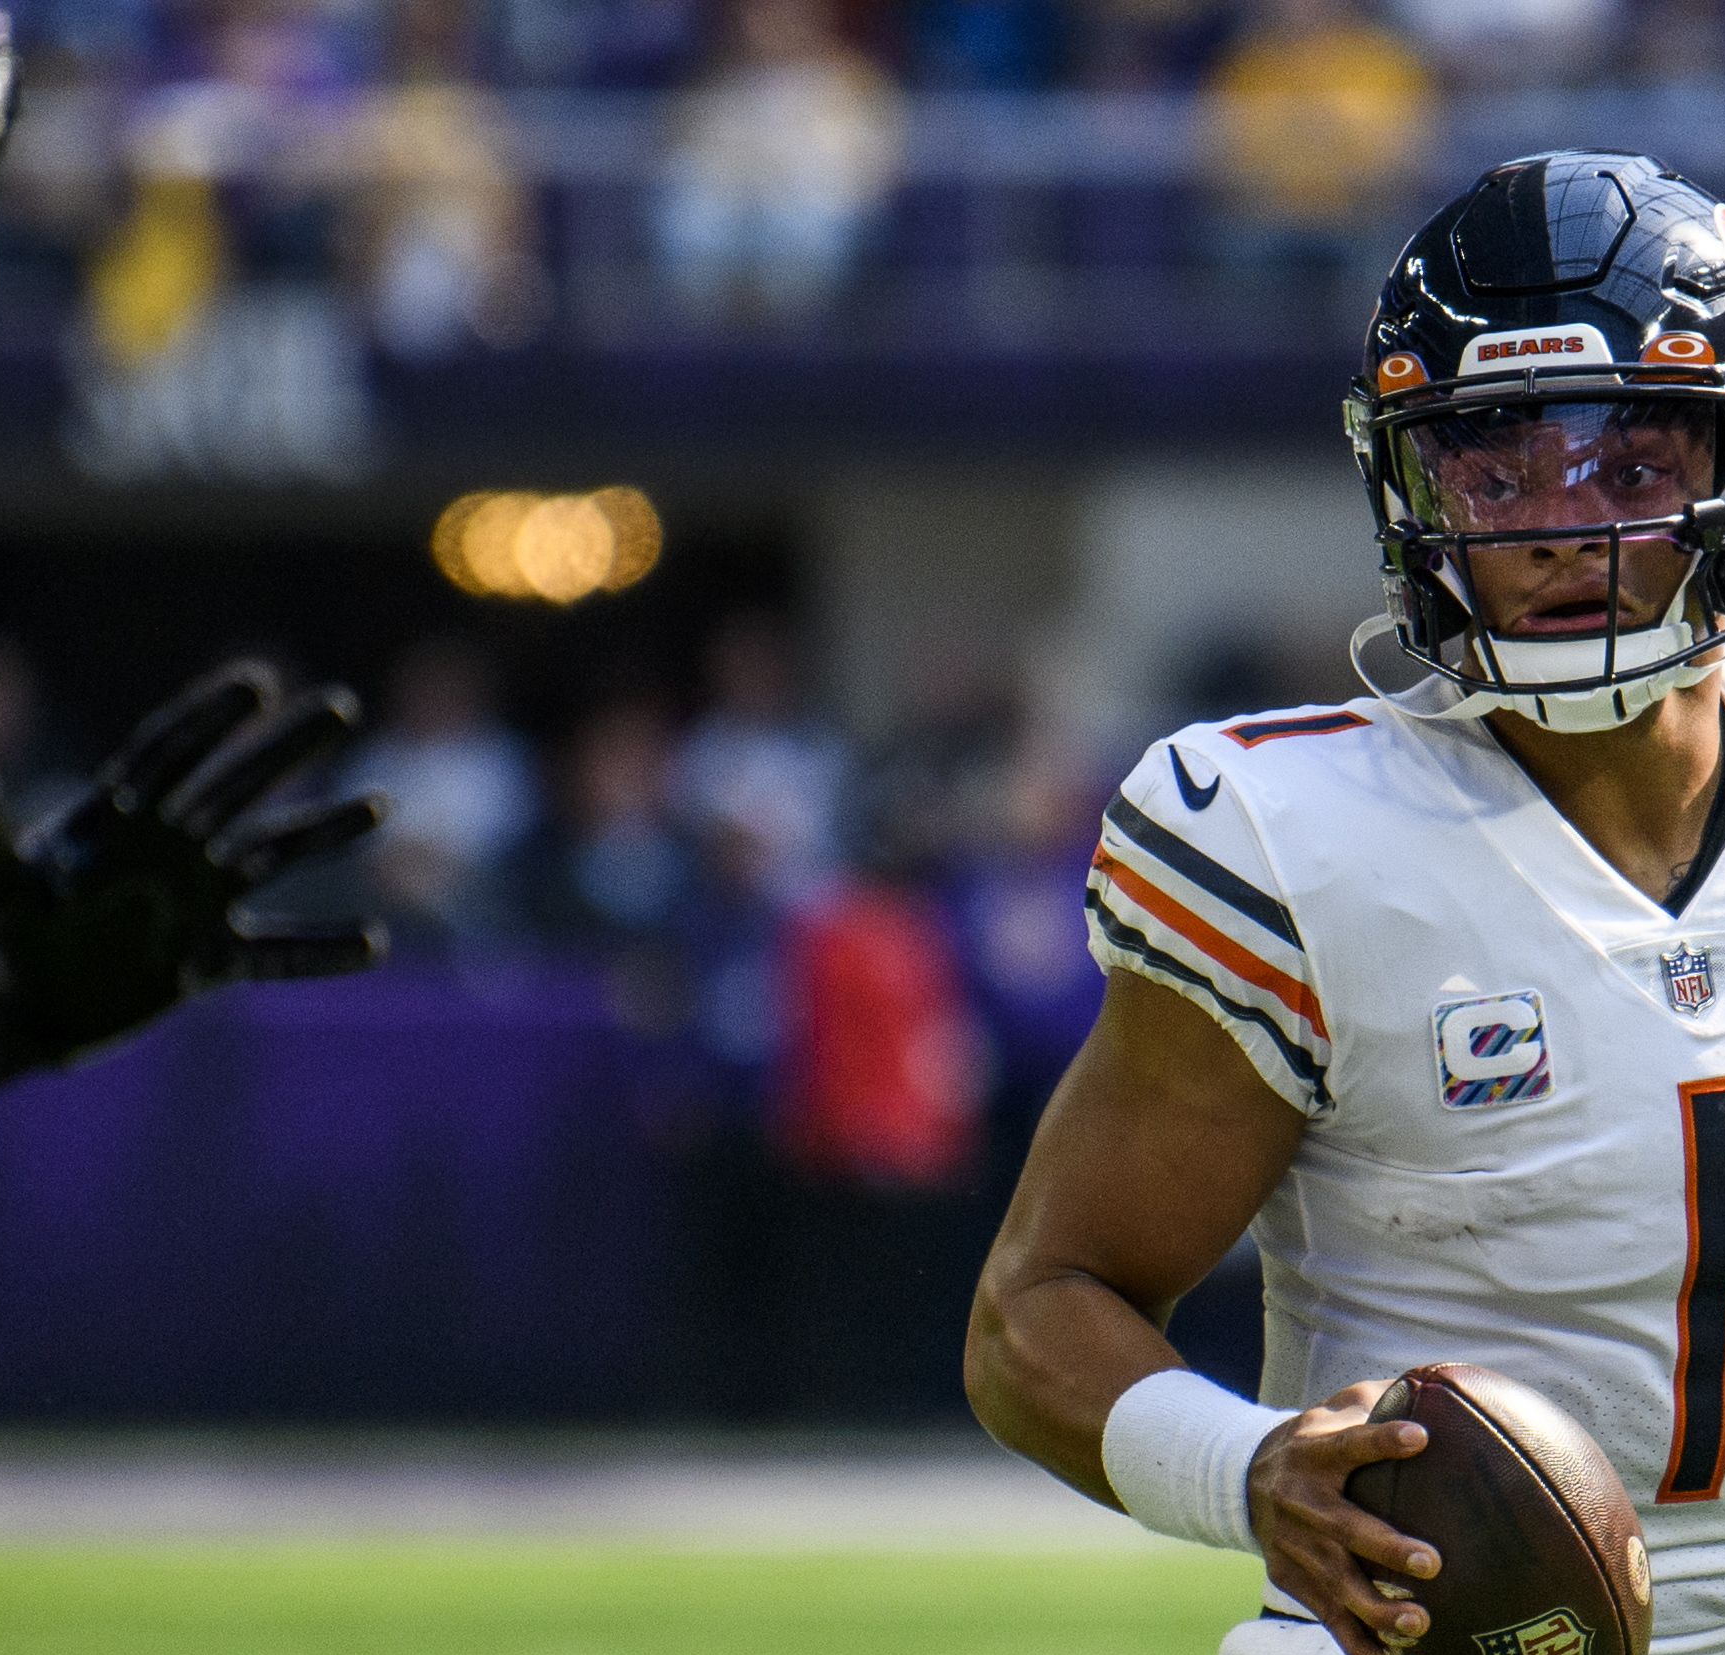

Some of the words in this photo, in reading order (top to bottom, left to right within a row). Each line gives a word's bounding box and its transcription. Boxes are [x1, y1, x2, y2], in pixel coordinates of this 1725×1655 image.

[1477, 337, 1584, 361] BEARS
[1218, 710, 1374, 750] 1
[1673, 974, 1710, 1003] NFL
[1441, 1000, 1541, 1081] C
